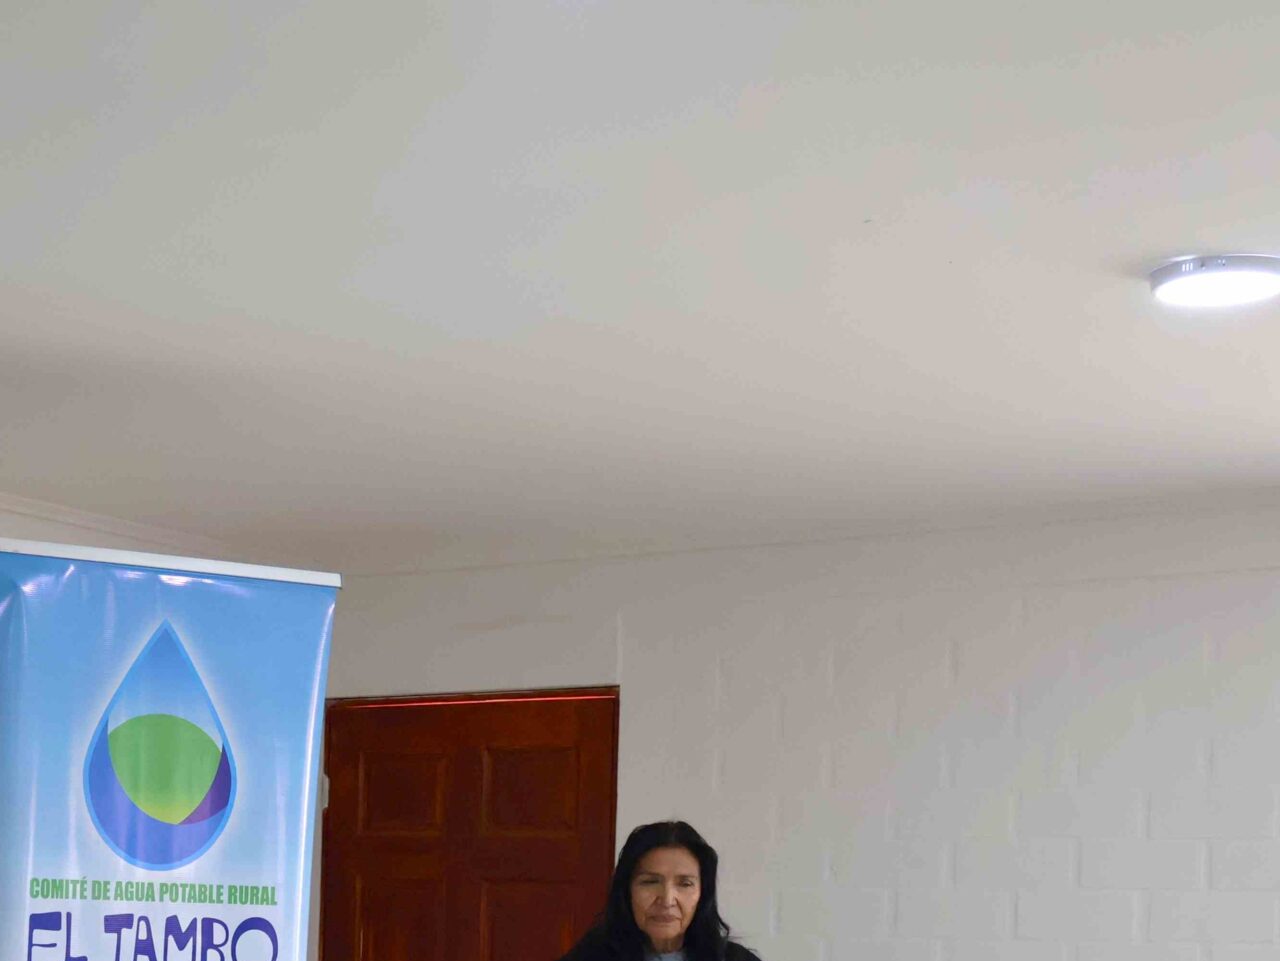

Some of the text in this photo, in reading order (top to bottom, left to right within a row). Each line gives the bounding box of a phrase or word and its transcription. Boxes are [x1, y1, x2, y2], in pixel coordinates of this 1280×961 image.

[29, 876, 278, 906] COMITÉ DE AGUA POTABLE RURAL
